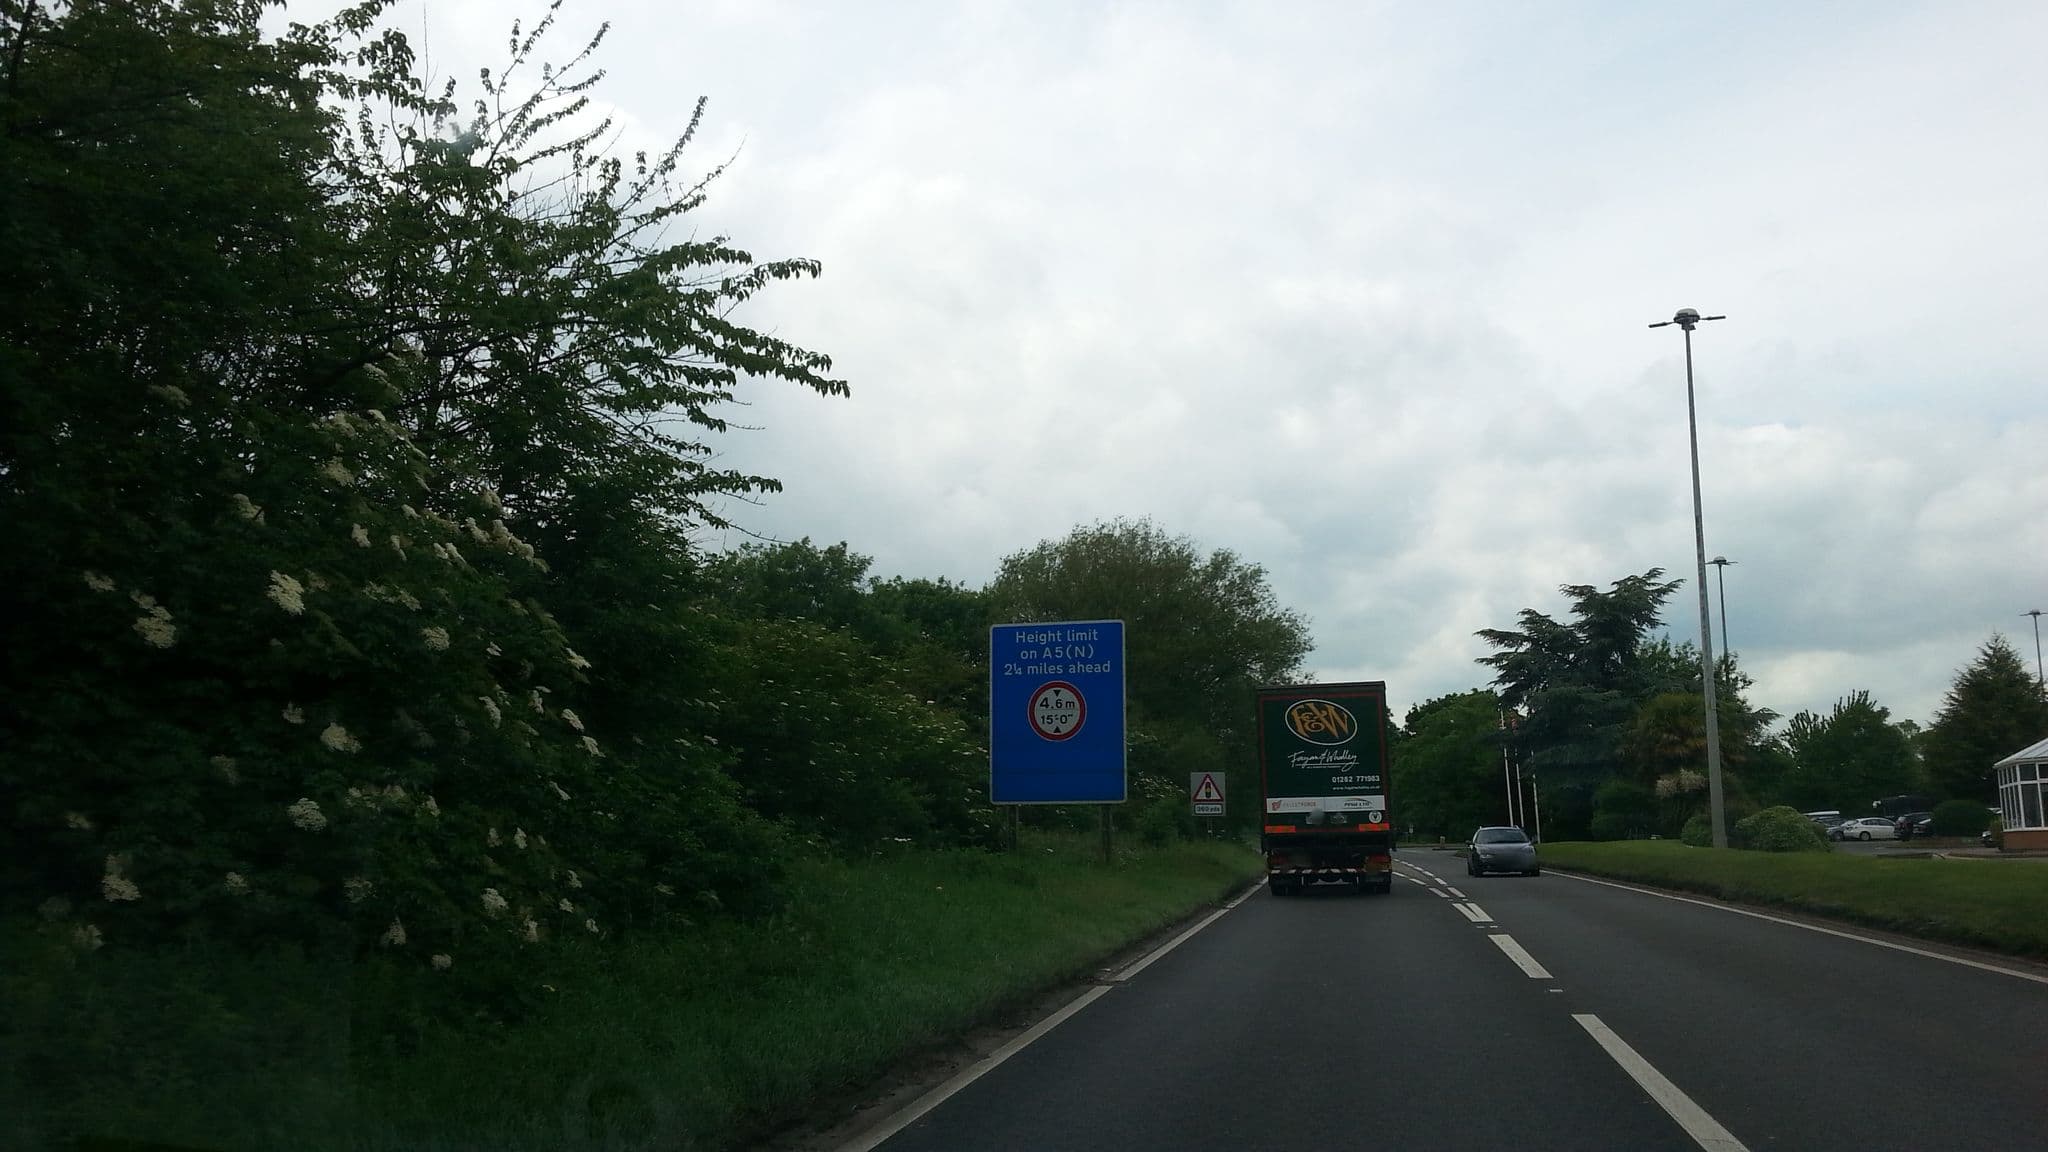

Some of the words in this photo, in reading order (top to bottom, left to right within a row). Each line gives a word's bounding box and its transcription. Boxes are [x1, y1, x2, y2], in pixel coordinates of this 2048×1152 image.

[1015, 630, 1062, 645] Height
[1066, 629, 1098, 642] limit
[1020, 649, 1037, 660] on
[1027, 662, 1063, 675] miles
[1068, 660, 1111, 673] ahead
